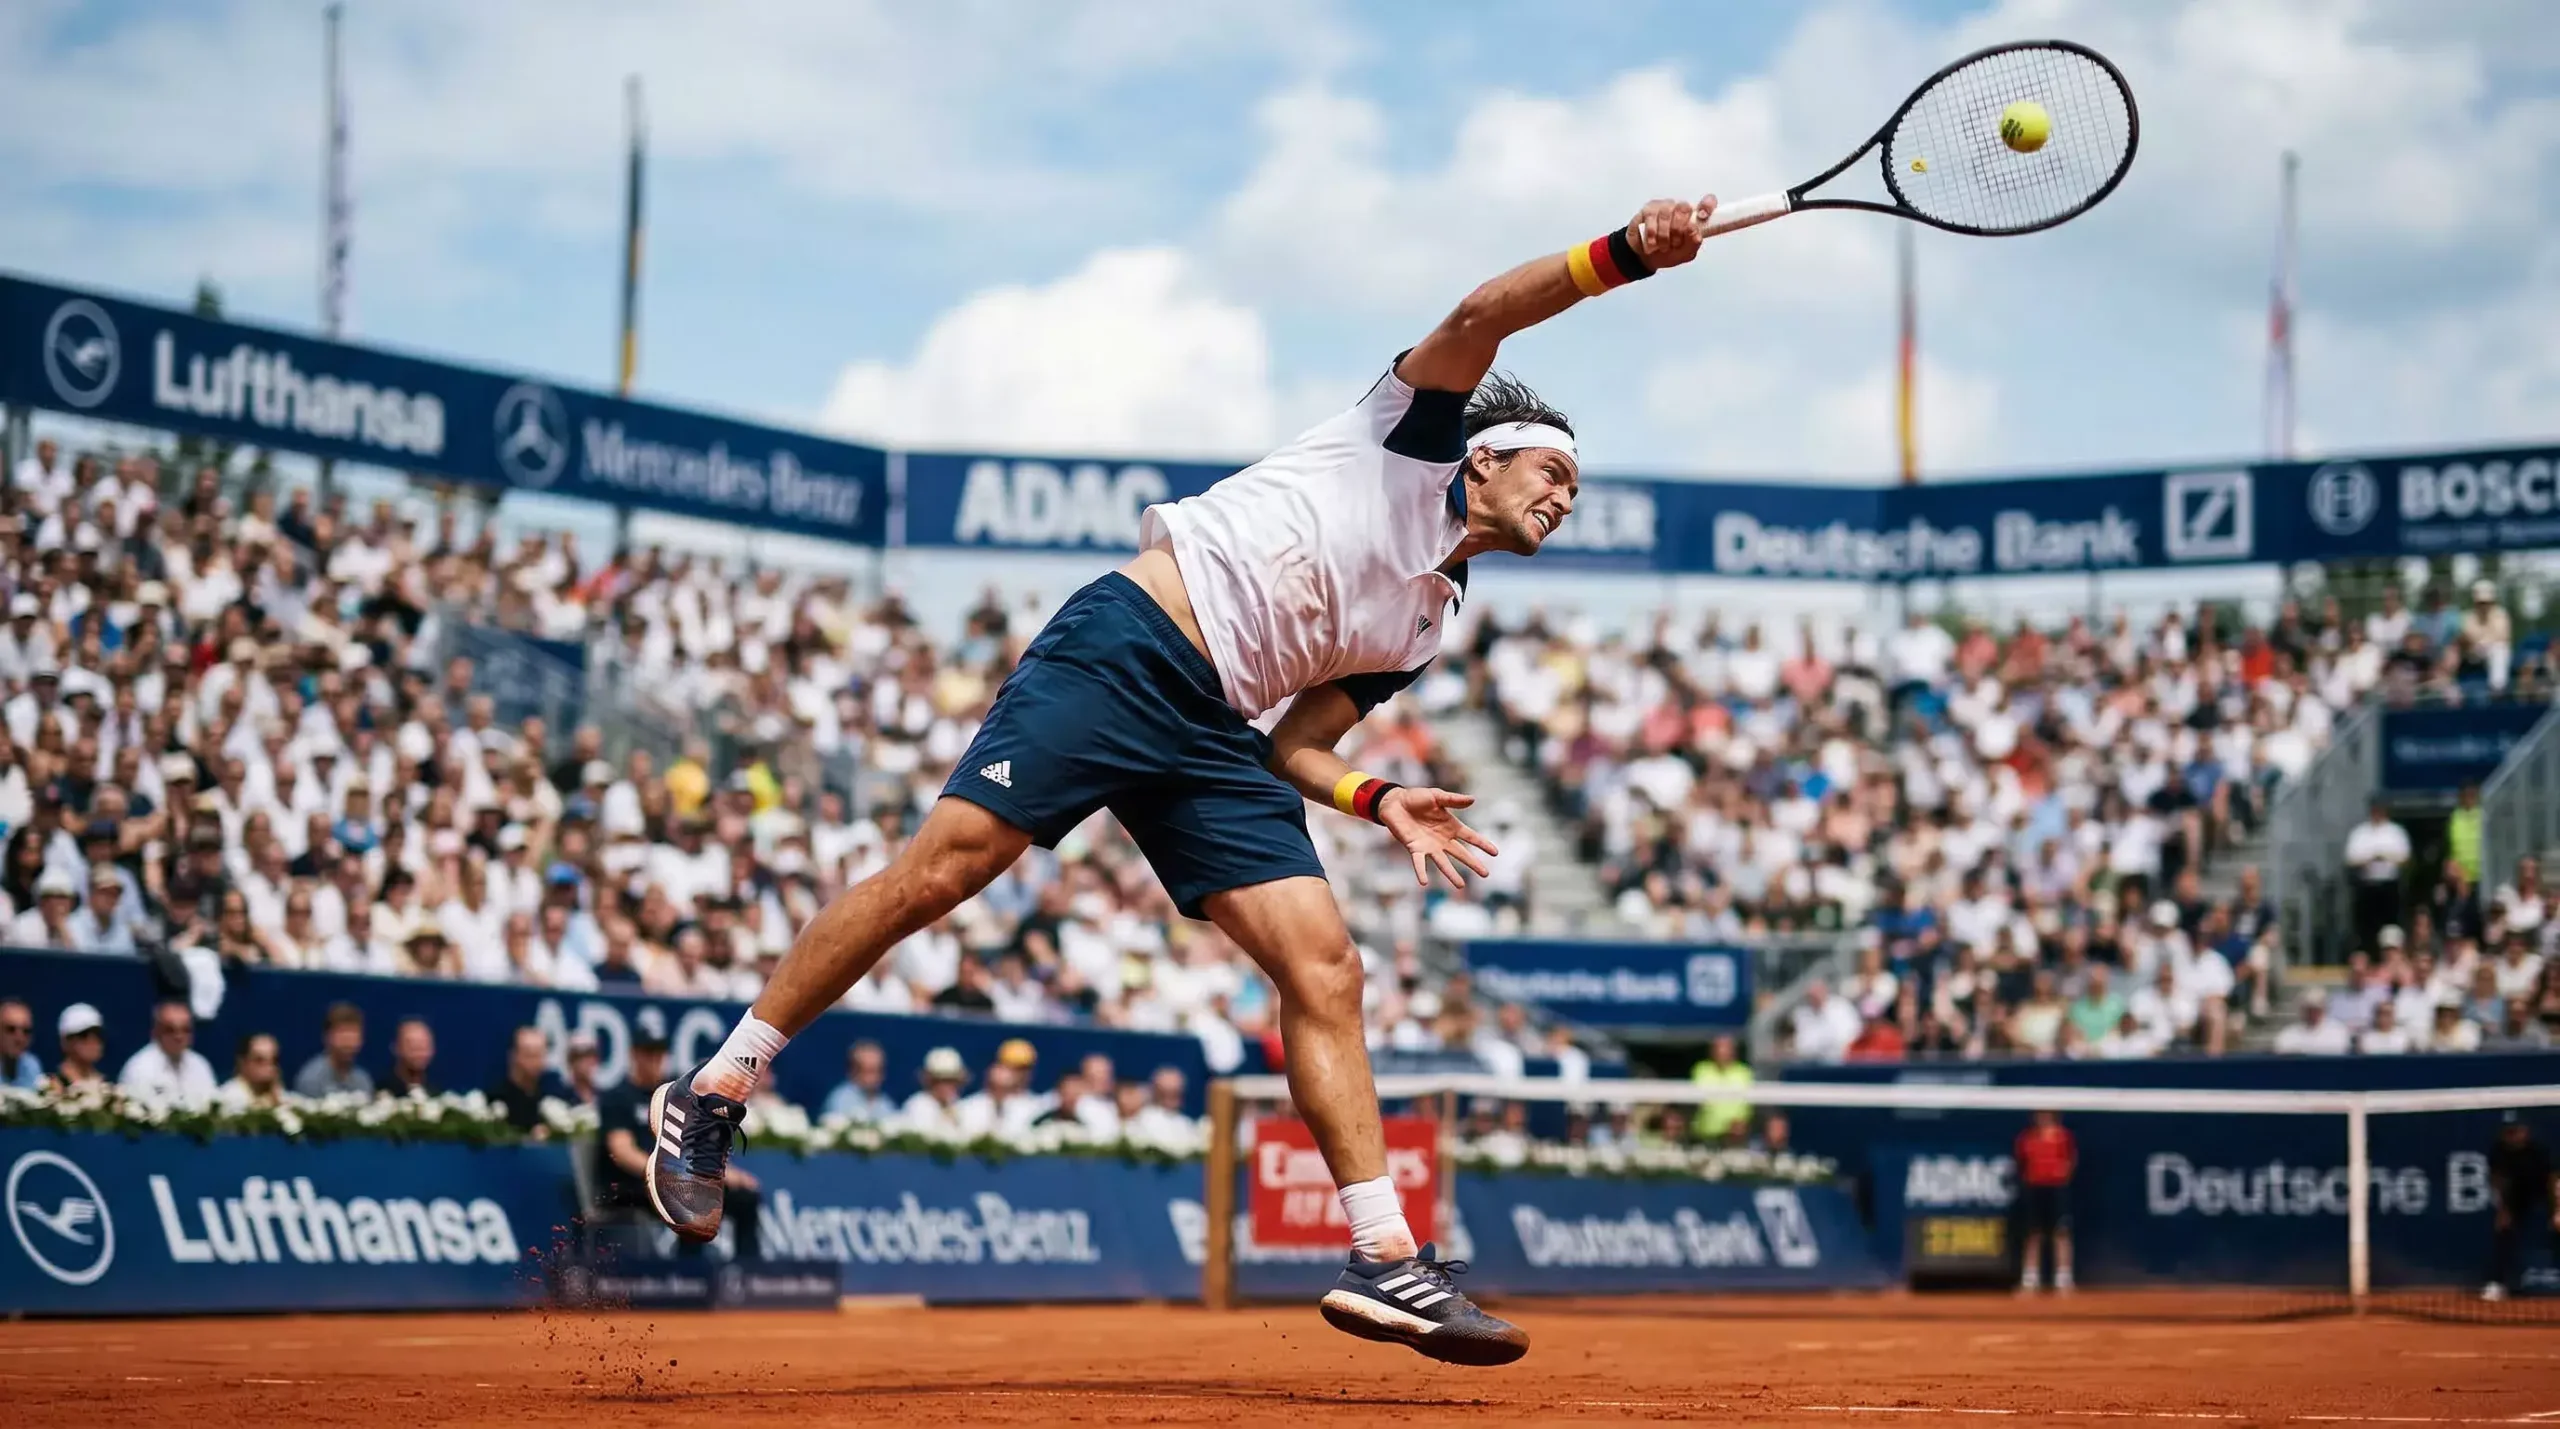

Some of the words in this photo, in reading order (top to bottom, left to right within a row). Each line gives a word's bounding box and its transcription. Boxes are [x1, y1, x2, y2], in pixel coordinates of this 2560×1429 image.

[154, 328, 446, 457] Lufthansa
[952, 460, 1171, 548] ADAC
[2398, 458, 2560, 521] BOSC
[1713, 511, 1983, 576] Deutsche
[1993, 506, 2139, 571] Bank
[149, 1173, 519, 1265] Lufthansa
[756, 1189, 1101, 1265] Mercedes-Benz
